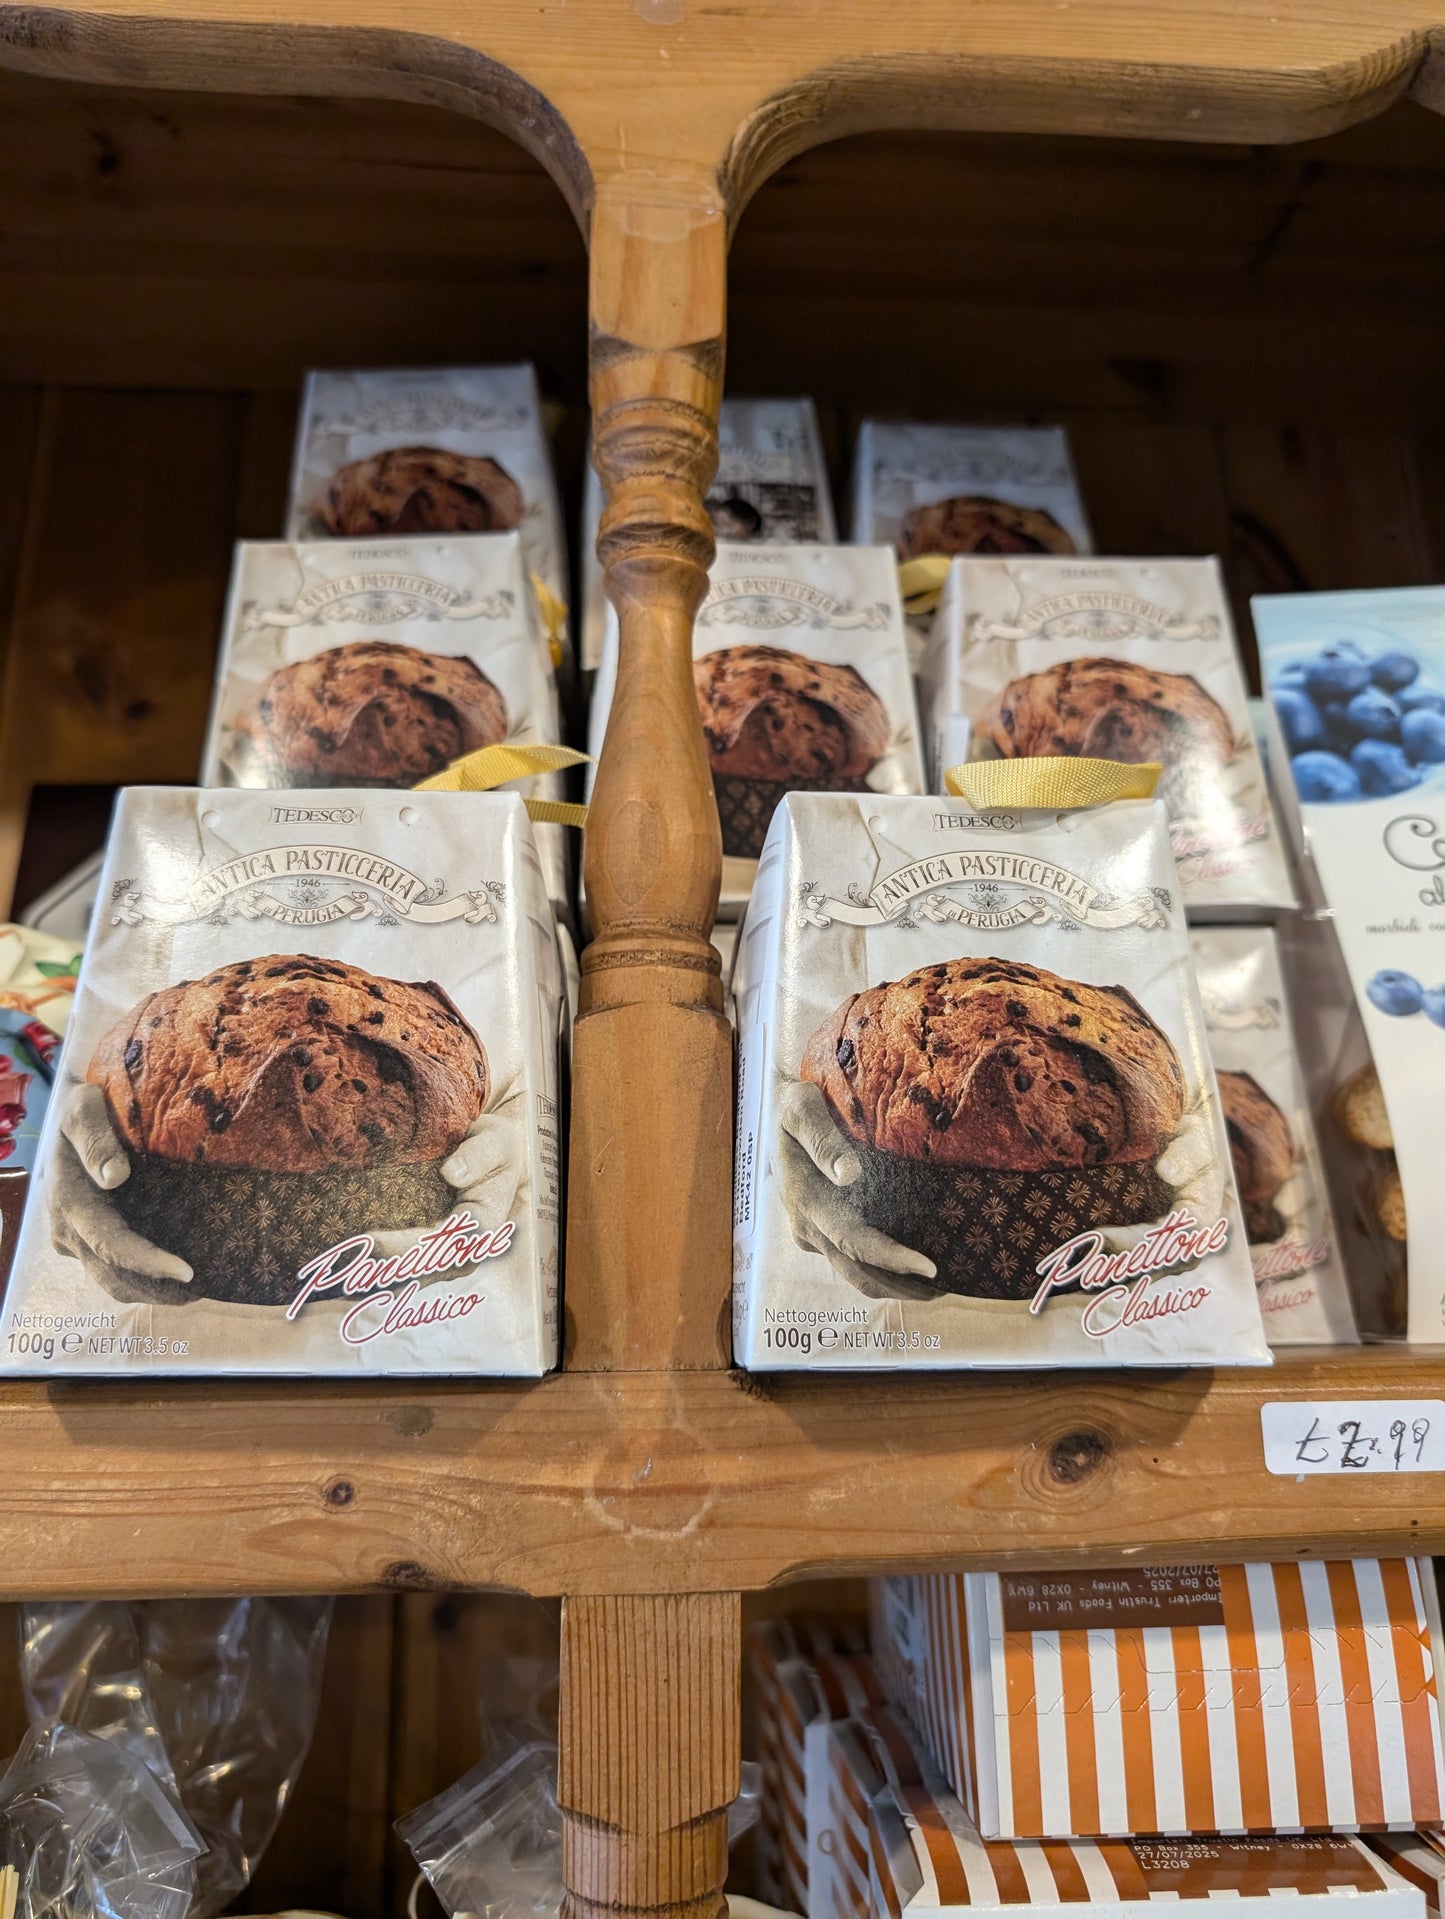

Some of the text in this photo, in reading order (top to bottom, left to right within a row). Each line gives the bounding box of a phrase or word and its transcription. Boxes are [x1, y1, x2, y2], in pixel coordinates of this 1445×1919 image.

[274, 808, 354, 823] TEDESCO
[935, 814, 1014, 829] TEDESCO
[201, 850, 416, 900] ANTICA PASTICCERIA
[296, 878, 321, 888] 1946
[882, 855, 1088, 905] ANTICA PASTICCERIA
[973, 883, 999, 893] 1946
[271, 903, 346, 924] PERUGIA
[957, 908, 1027, 928] PERUGIA
[738, 1152, 746, 1224] Bedford
[744, 1170, 752, 1221] MK42
[287, 1211, 516, 1320] Panettone
[1031, 1209, 1229, 1314] Panettone
[341, 1282, 487, 1345] Classico
[1083, 1276, 1212, 1338] Classico
[11, 1312, 117, 1332] Nettogewicht
[764, 1307, 868, 1328] Nettogewicht
[8, 1332, 55, 1360] 100g
[88, 1337, 116, 1354] NET
[119, 1337, 142, 1354] WT
[144, 1337, 168, 1354] 3.5
[172, 1341, 189, 1354] oz
[763, 1327, 812, 1355] 100g
[844, 1332, 870, 1349] NET
[872, 1332, 894, 1349] WT
[897, 1331, 920, 1349] 3.5
[924, 1336, 941, 1349] oz
[1092, 1579, 1130, 1592] Witney
[1151, 1580, 1172, 1590] 355
[1179, 1578, 1199, 1589] Box
[1205, 1576, 1222, 1588] PO
[1028, 1592, 1223, 1612] Importer: Trustin Foods UK Ltd
[1137, 1850, 1220, 1860] 27/07/2025
[1229, 1843, 1270, 1852] Witney
[1141, 1860, 1190, 1870] L3208
